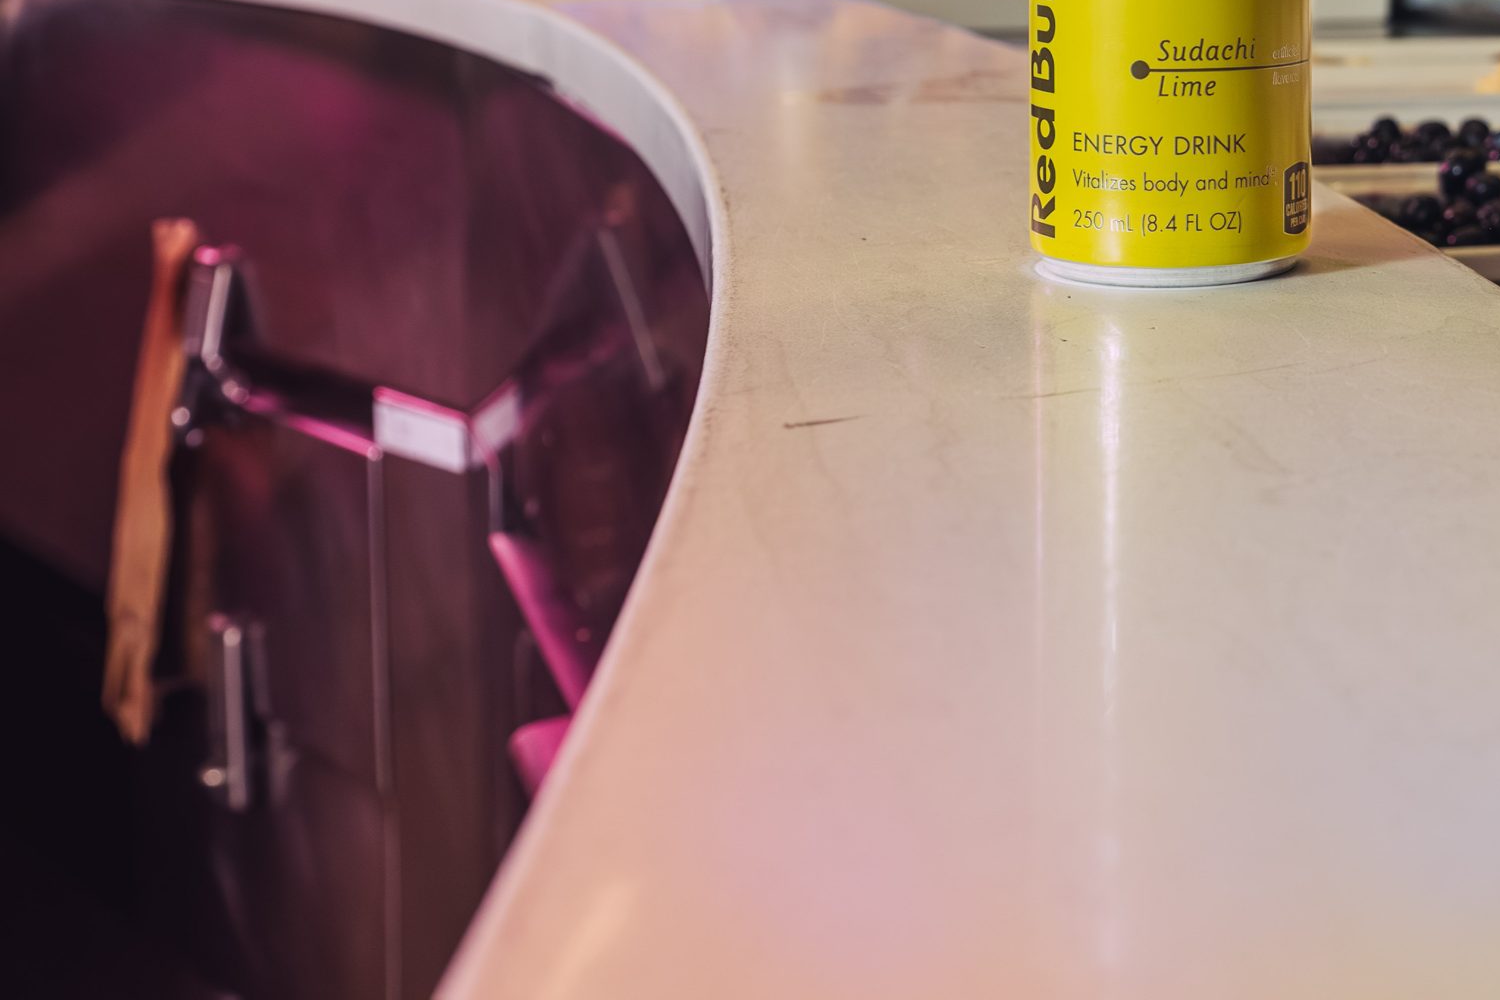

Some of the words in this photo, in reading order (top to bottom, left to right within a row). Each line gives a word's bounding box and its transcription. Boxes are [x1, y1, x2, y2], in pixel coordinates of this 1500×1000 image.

[1156, 36, 1258, 62] Sudachi
[1157, 75, 1217, 98] Lime
[1072, 131, 1163, 157] ENERGY
[1173, 133, 1247, 156] DRINK
[1030, 103, 1057, 240] Red
[1072, 168, 1137, 191] Vitalizes
[1143, 171, 1189, 198] body
[1195, 172, 1229, 191] and
[1289, 167, 1307, 201] 110
[1072, 208, 1105, 230] 250
[1109, 214, 1134, 234] mL
[1141, 213, 1178, 238] (8.4
[1185, 212, 1203, 232] FL
[1209, 210, 1243, 235] OZ)
